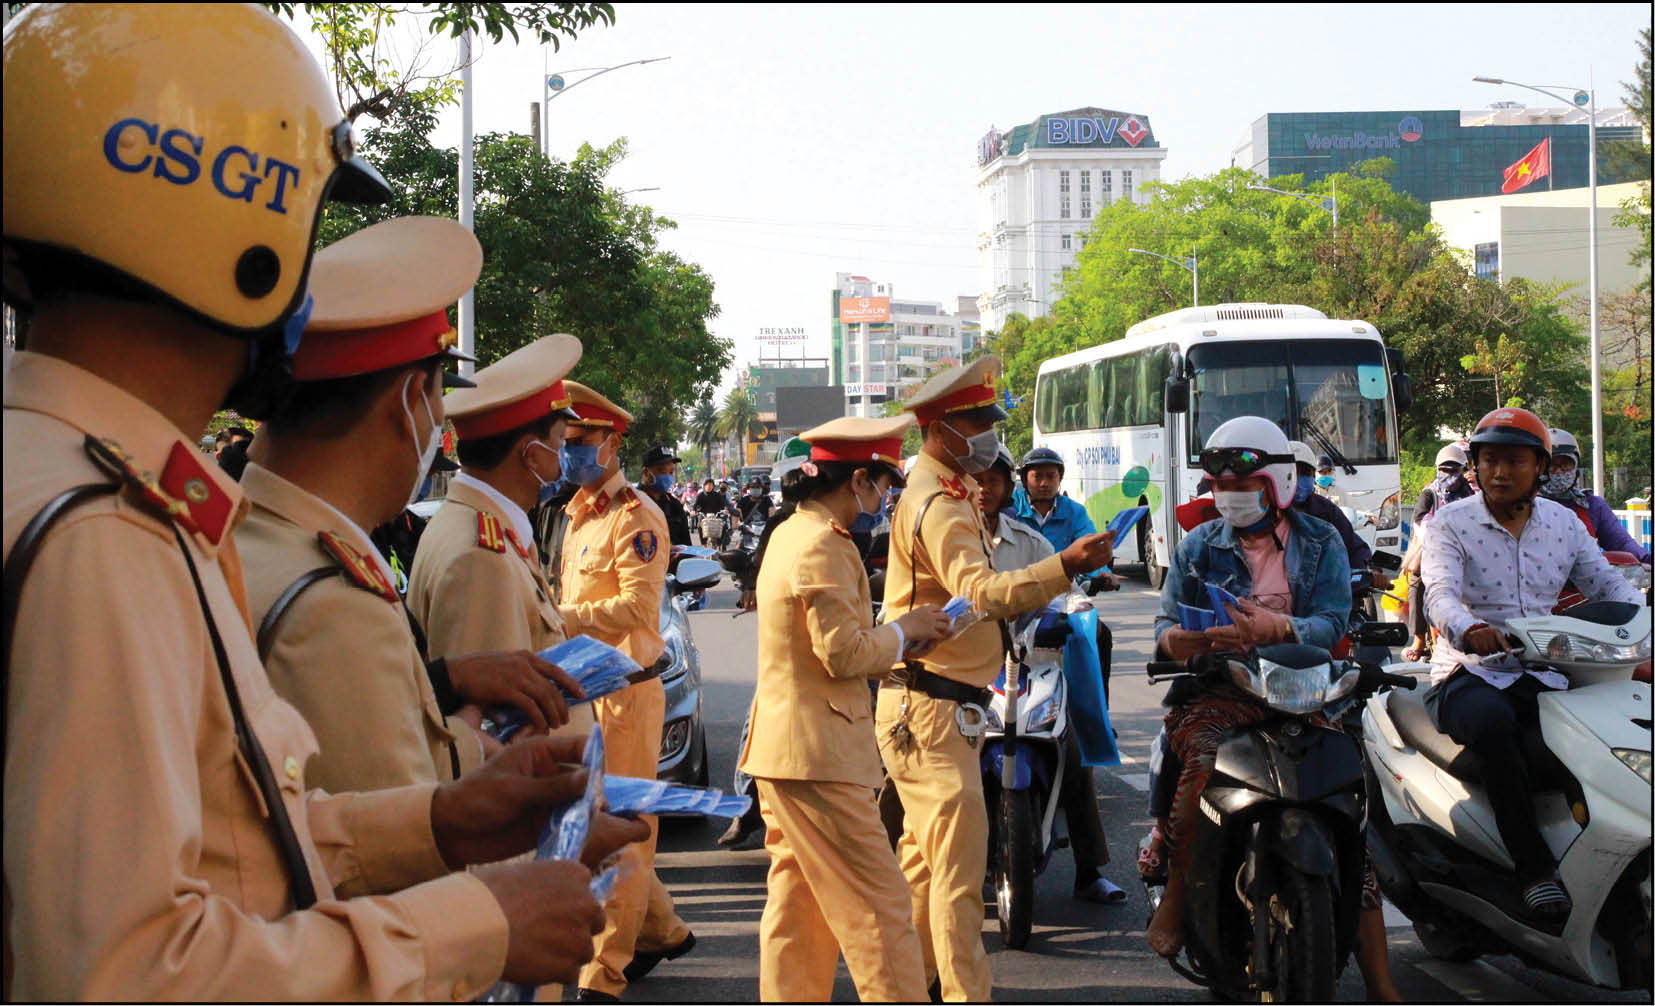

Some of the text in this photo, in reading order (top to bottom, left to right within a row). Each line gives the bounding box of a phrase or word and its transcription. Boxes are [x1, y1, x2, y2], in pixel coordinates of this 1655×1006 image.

[1048, 118, 1119, 144] BIDV
[1304, 129, 1400, 150] VietinBank
[103, 118, 300, 214] CSGT
[847, 384, 885, 393] DAY STAR
[1199, 795, 1222, 827] YAMAHA
